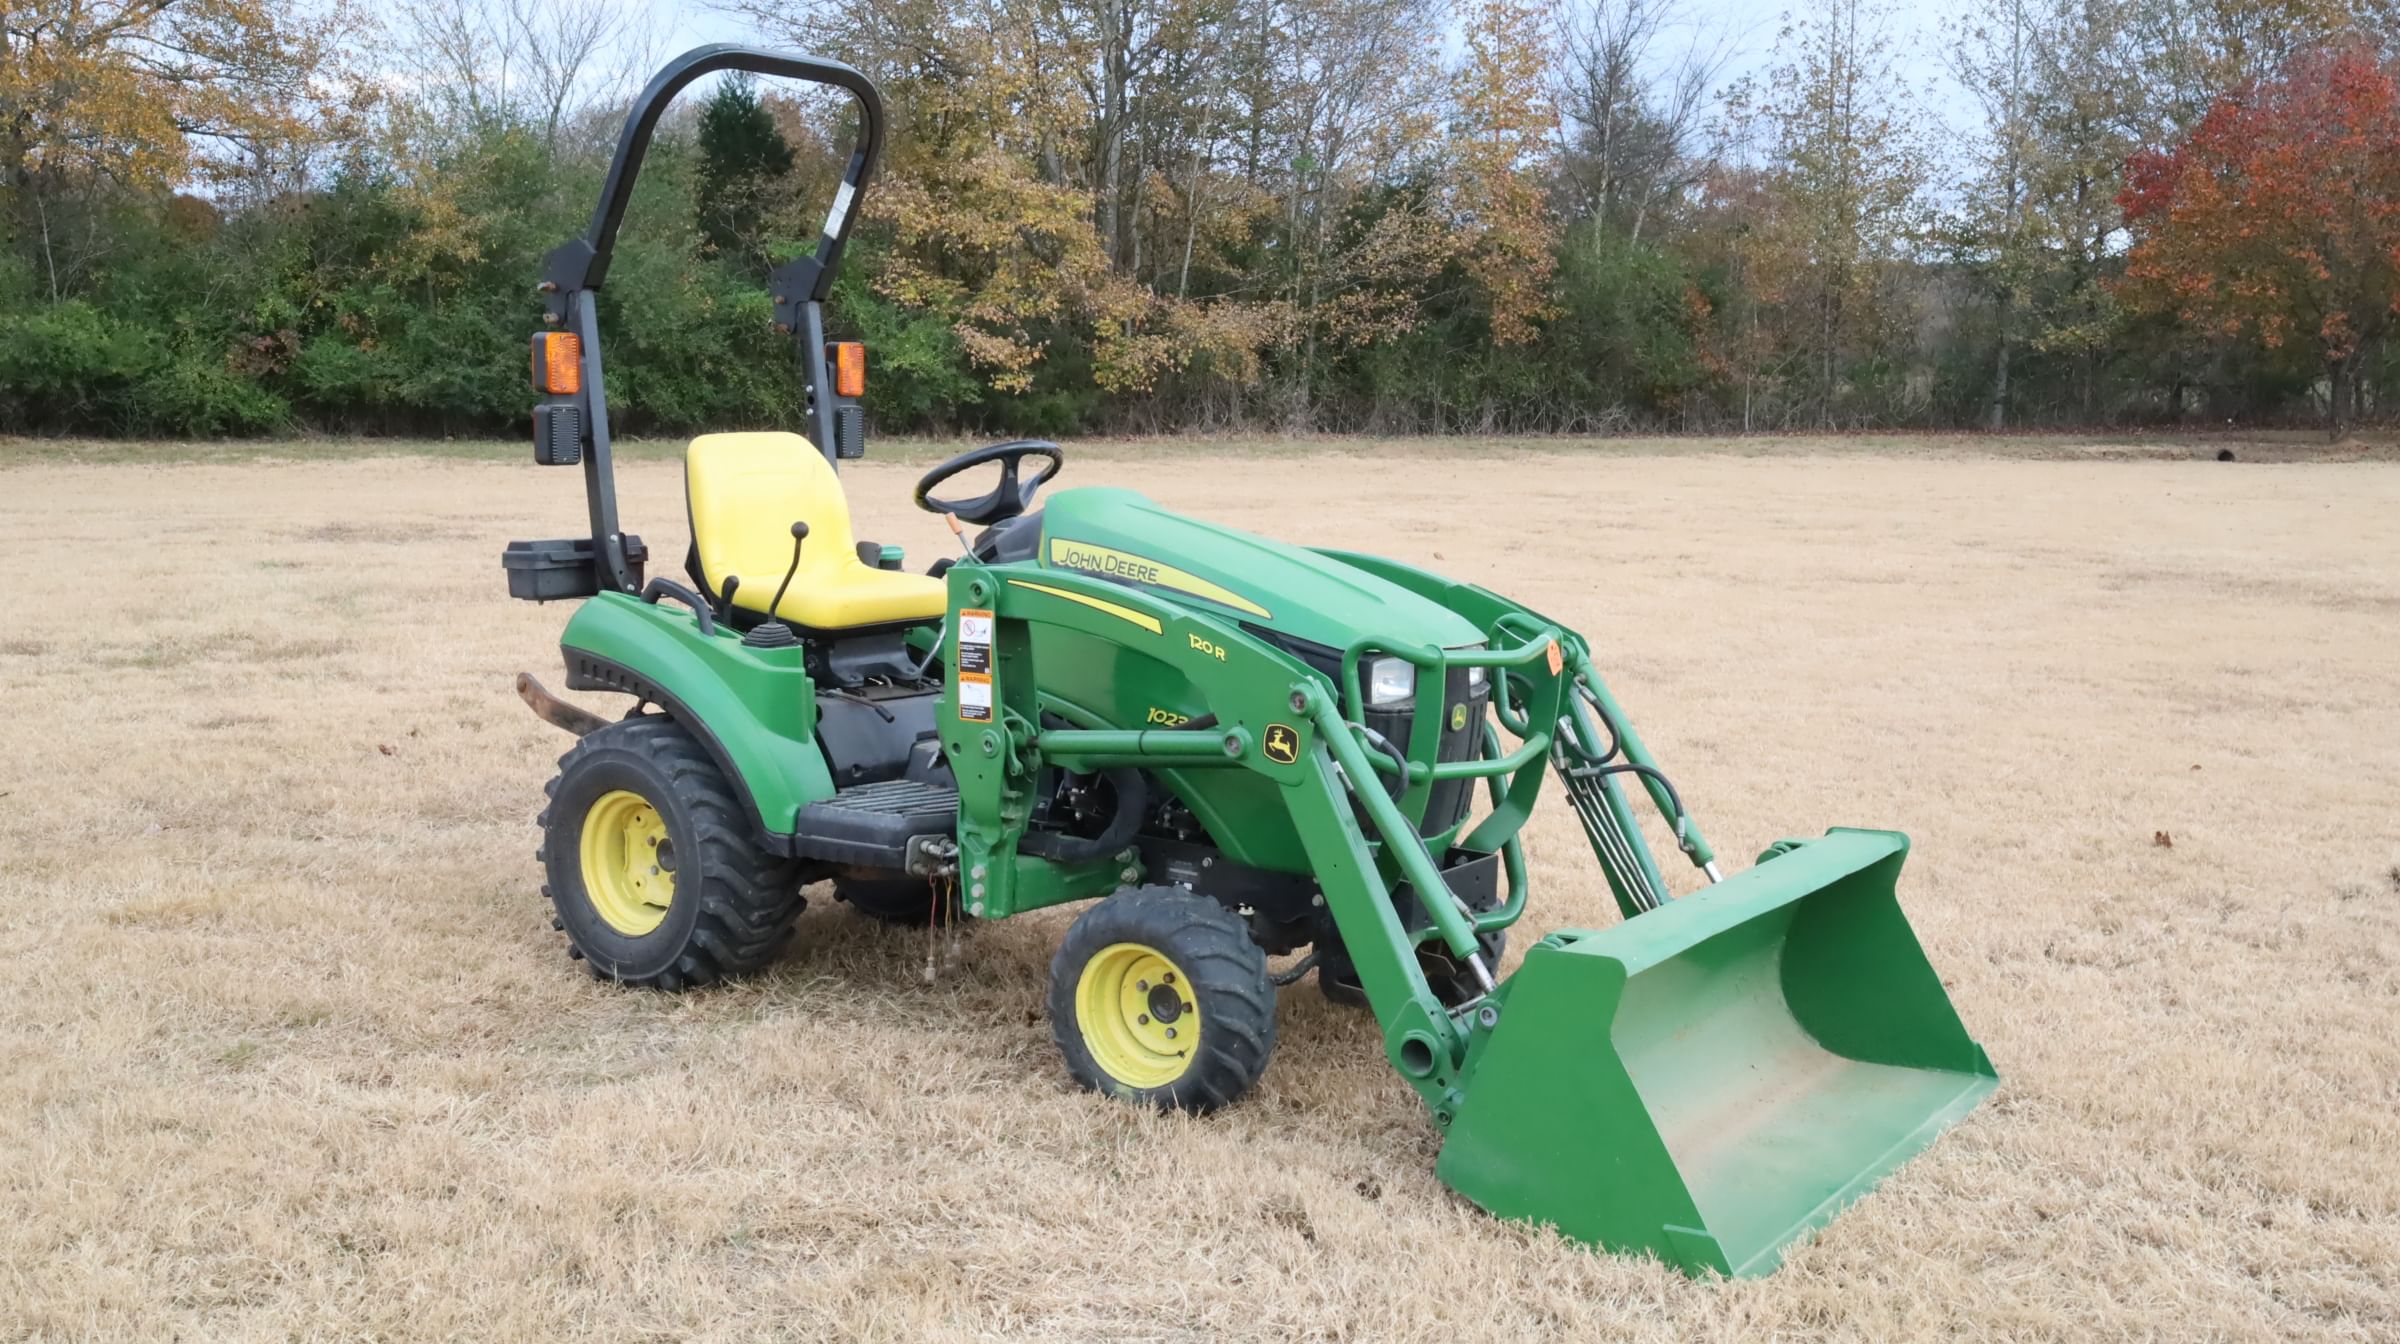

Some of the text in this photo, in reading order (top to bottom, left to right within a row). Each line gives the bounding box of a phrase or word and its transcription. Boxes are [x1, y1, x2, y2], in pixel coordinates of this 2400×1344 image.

[1060, 547, 1159, 582] JOHN DEERE
[1188, 632, 1225, 661] 120 R
